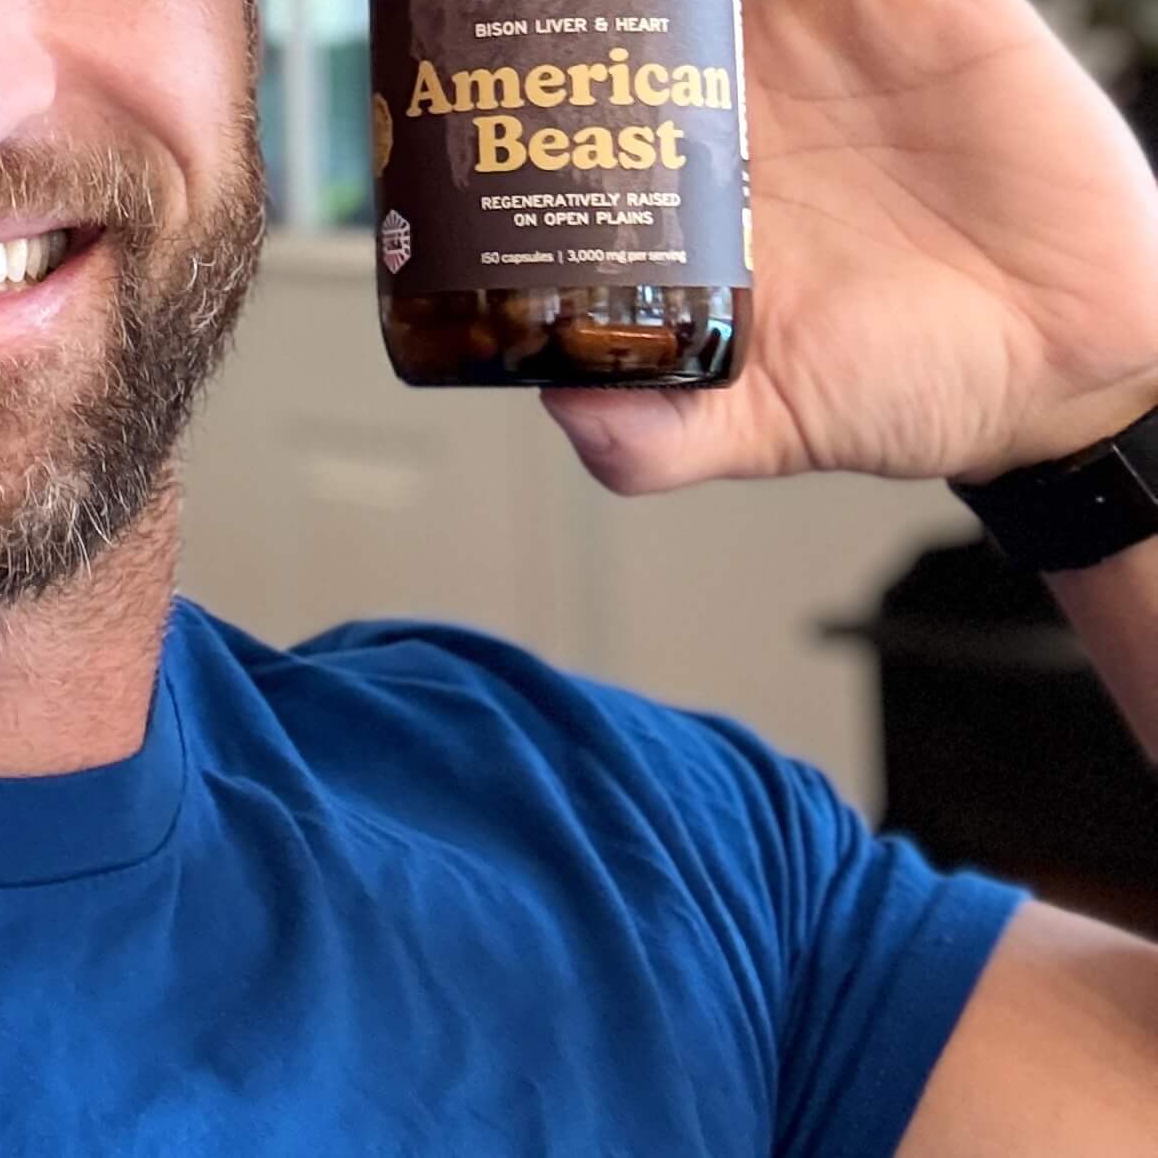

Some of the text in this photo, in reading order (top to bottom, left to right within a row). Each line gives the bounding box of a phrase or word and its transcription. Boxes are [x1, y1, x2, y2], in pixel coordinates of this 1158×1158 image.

[475, 17, 670, 38] BISON LIVER & HEART
[406, 48, 732, 117] American
[472, 115, 686, 173] Beast
[481, 192, 681, 210] REGENERATIVELY RAISED
[514, 211, 654, 226] ON OPEN PLAINS
[567, 249, 605, 263] 3,000
